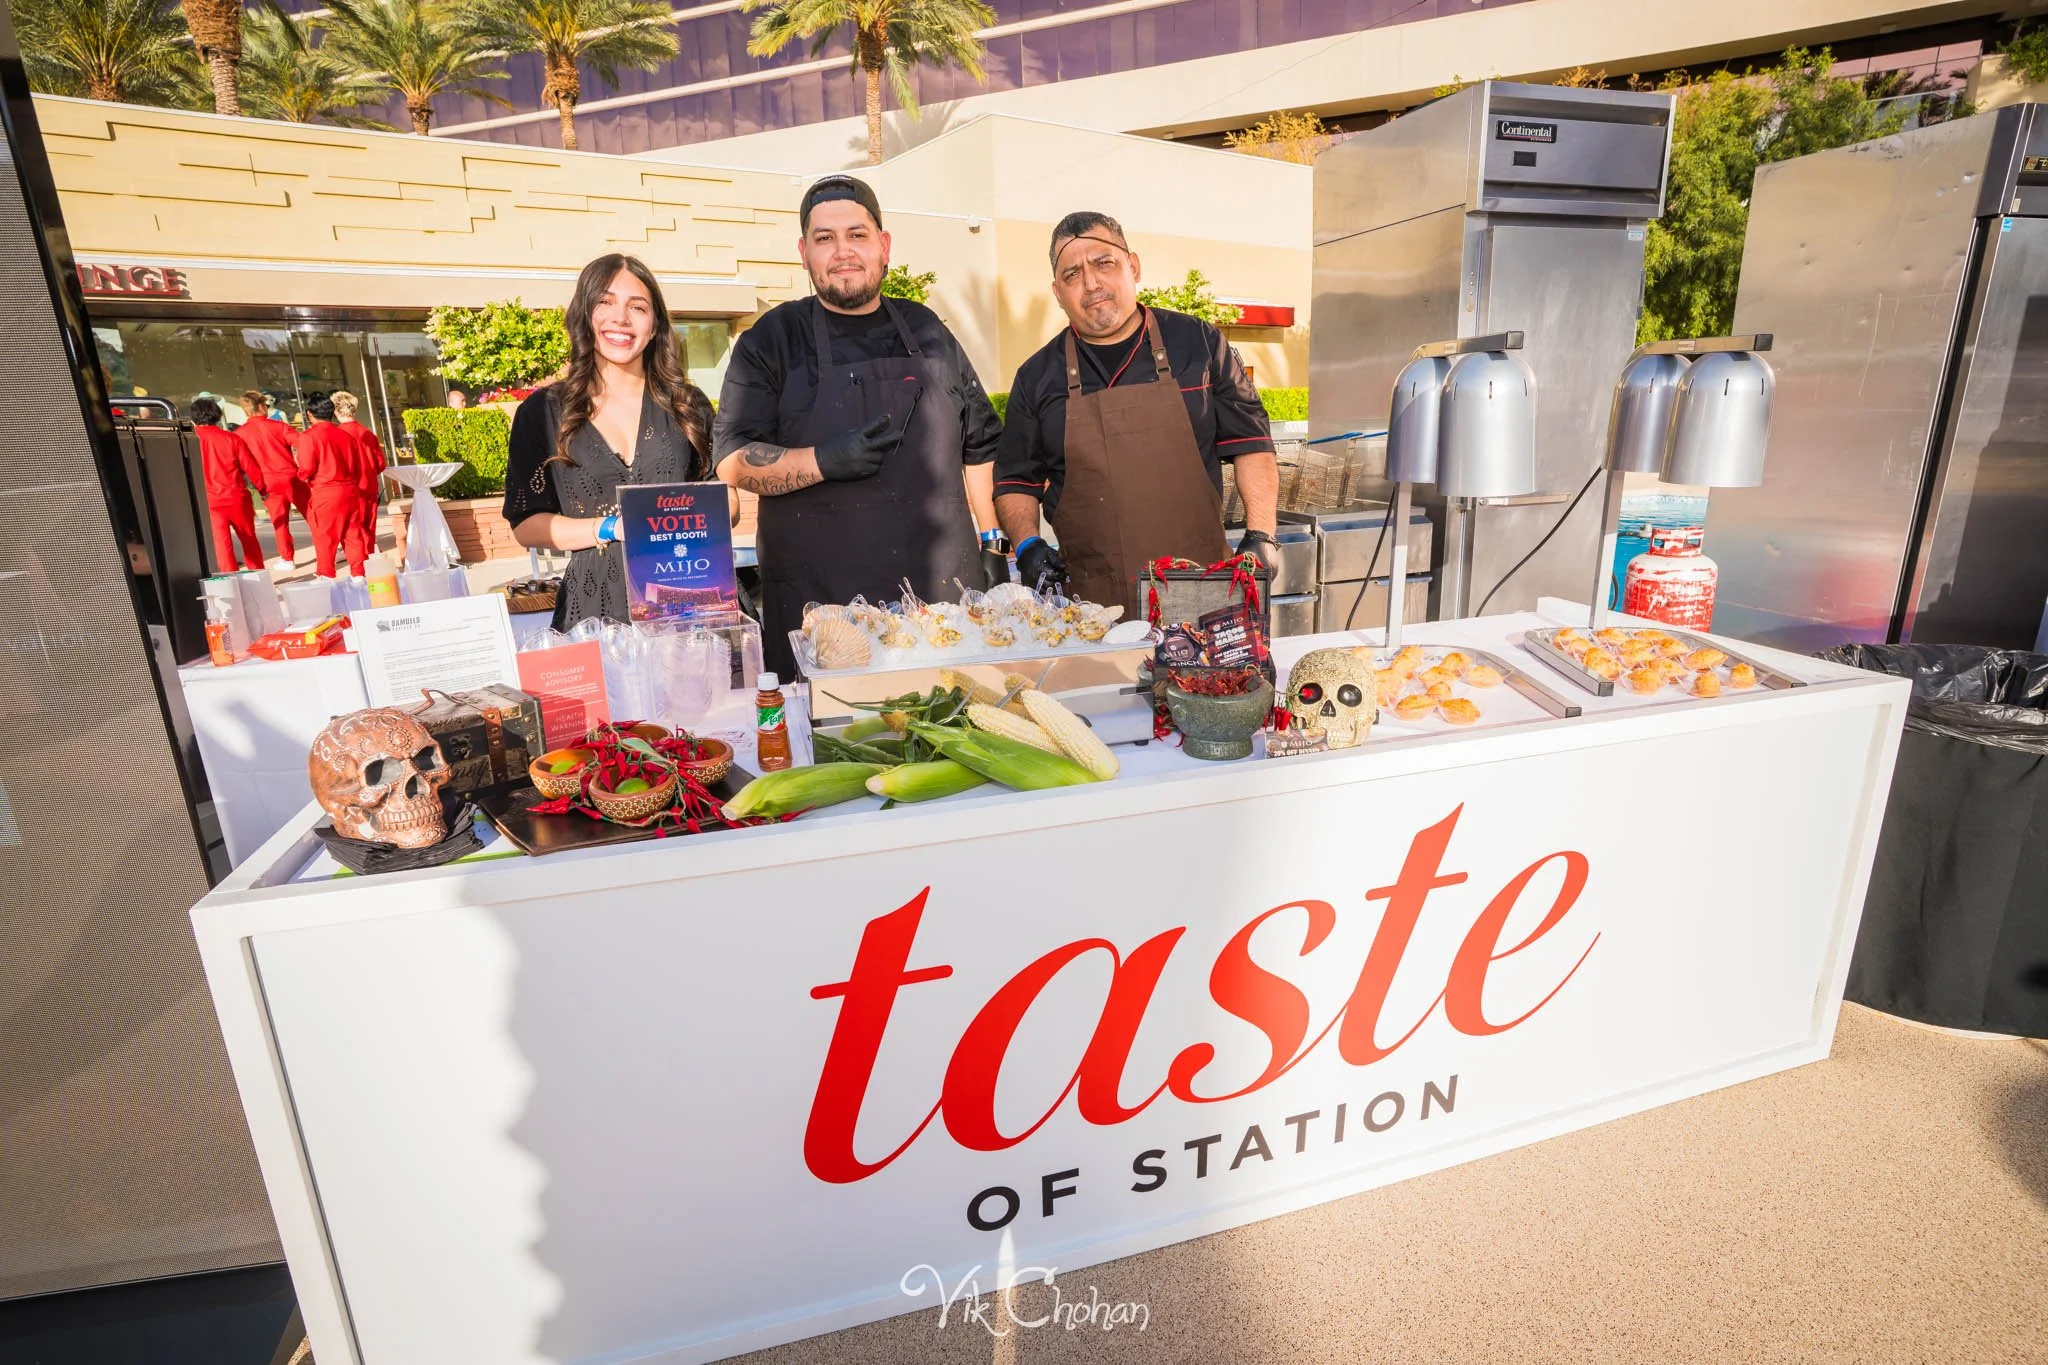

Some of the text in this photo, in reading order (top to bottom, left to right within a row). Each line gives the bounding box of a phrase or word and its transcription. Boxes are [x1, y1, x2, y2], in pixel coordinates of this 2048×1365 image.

[1501, 121, 1552, 137] Continental
[656, 492, 696, 509] taste
[646, 513, 708, 533] VOTE
[650, 530, 708, 542] BEST BOOTH
[653, 558, 710, 575] MIJO
[803, 802, 1601, 1185] taste
[966, 1074, 1459, 1232] OF STATION
